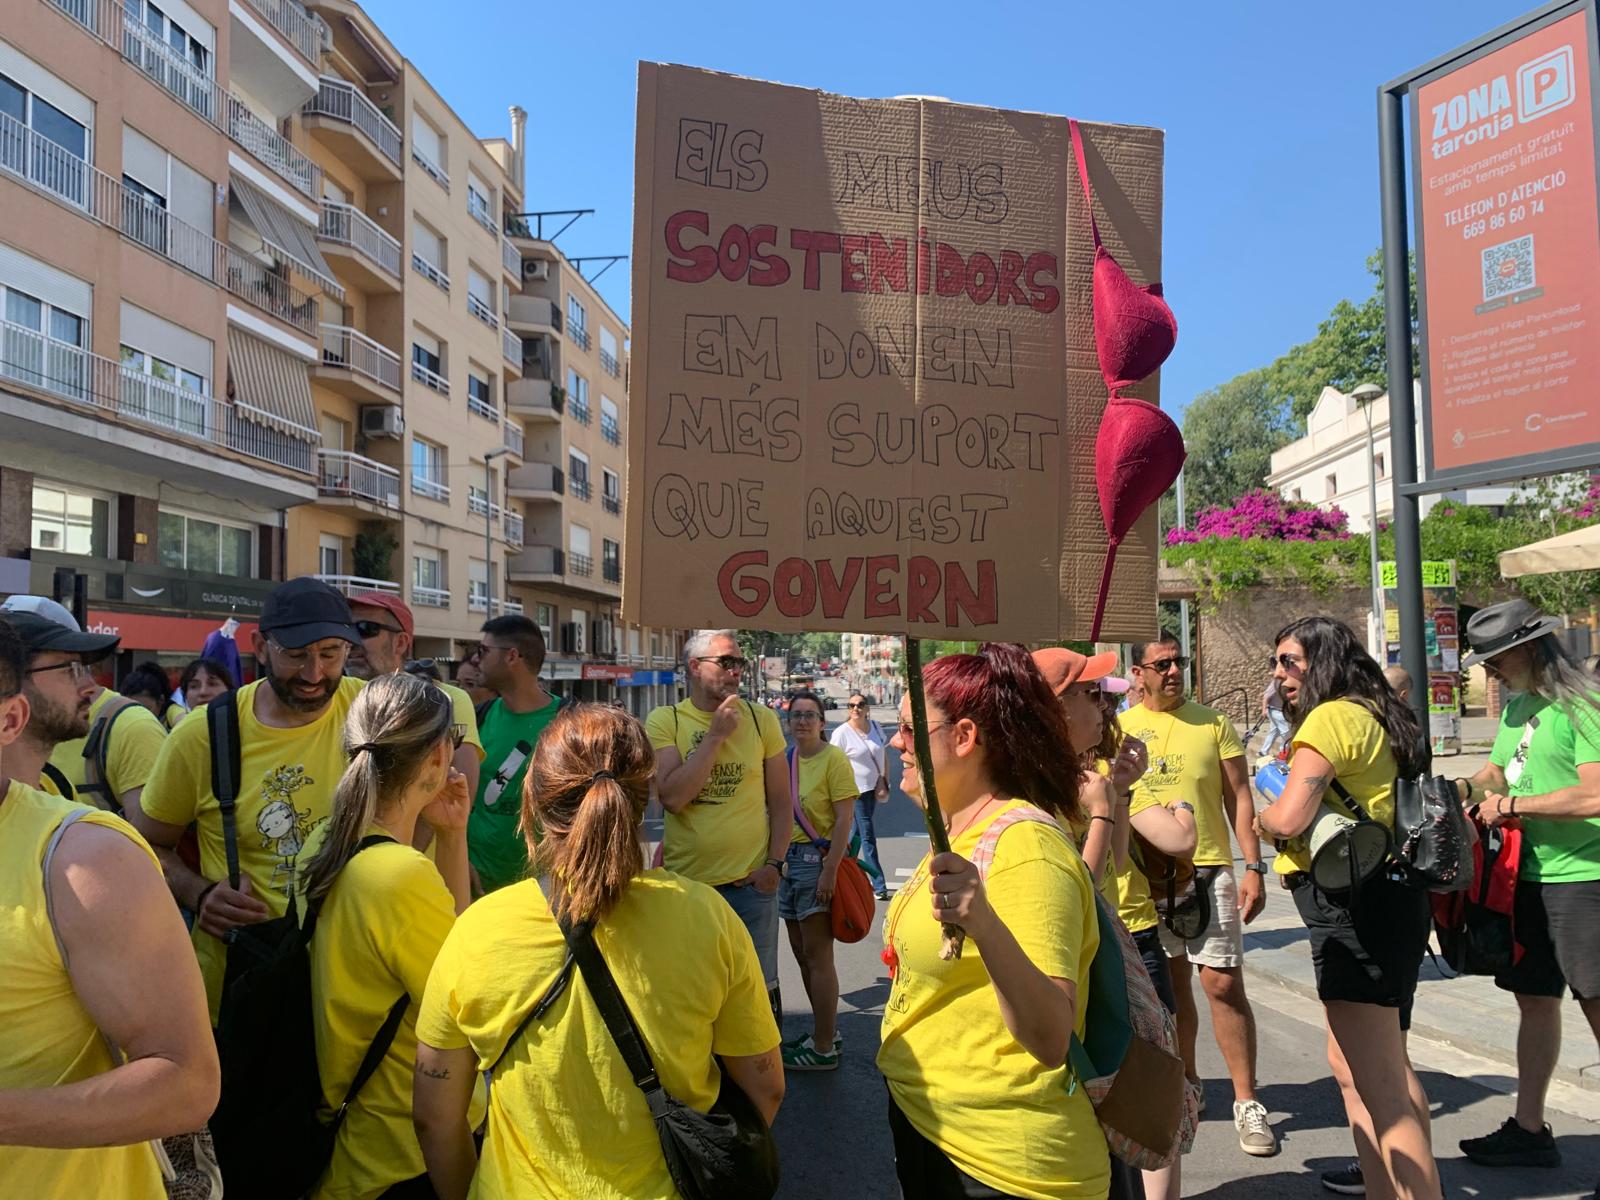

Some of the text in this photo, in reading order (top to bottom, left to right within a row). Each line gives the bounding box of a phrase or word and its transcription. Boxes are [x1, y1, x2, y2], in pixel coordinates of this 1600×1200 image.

[1431, 74, 1512, 140] ZONA
[1432, 113, 1514, 160] taronja
[675, 118, 1009, 224] ELS MEUS
[1429, 142, 1523, 189] Estacionament
[1444, 142, 1563, 196] amb temps limitat
[1463, 199, 1545, 239] 669 86 60 74
[683, 314, 1015, 389] EM DONEN
[658, 384, 1059, 471] MÉS SUPORT
[652, 473, 1008, 544] QUE AQUEST
[717, 550, 998, 628] GOVERN
